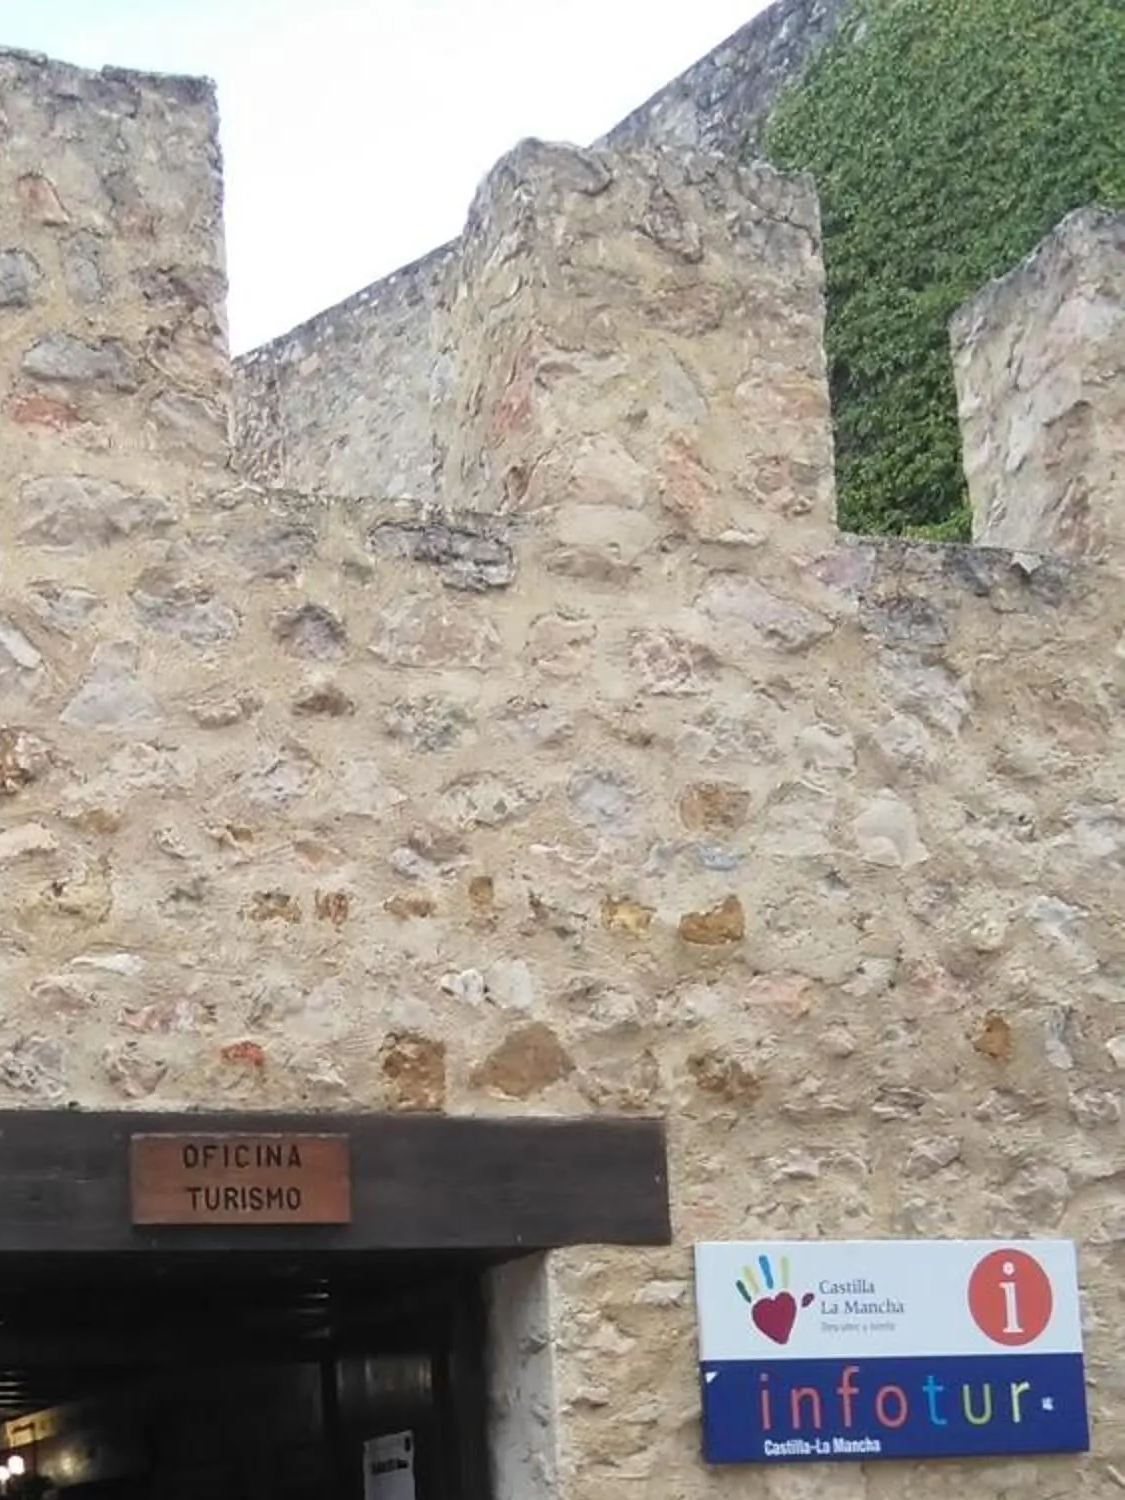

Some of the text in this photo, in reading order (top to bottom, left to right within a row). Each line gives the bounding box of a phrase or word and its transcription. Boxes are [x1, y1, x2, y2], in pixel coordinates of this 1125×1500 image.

[183, 1145, 302, 1168] OFICINA
[187, 1186, 301, 1211] TURISMO
[819, 1279, 875, 1295] Castilla
[821, 1299, 905, 1315] La Mancha
[764, 1437, 881, 1456] Castilla-La Mancha
